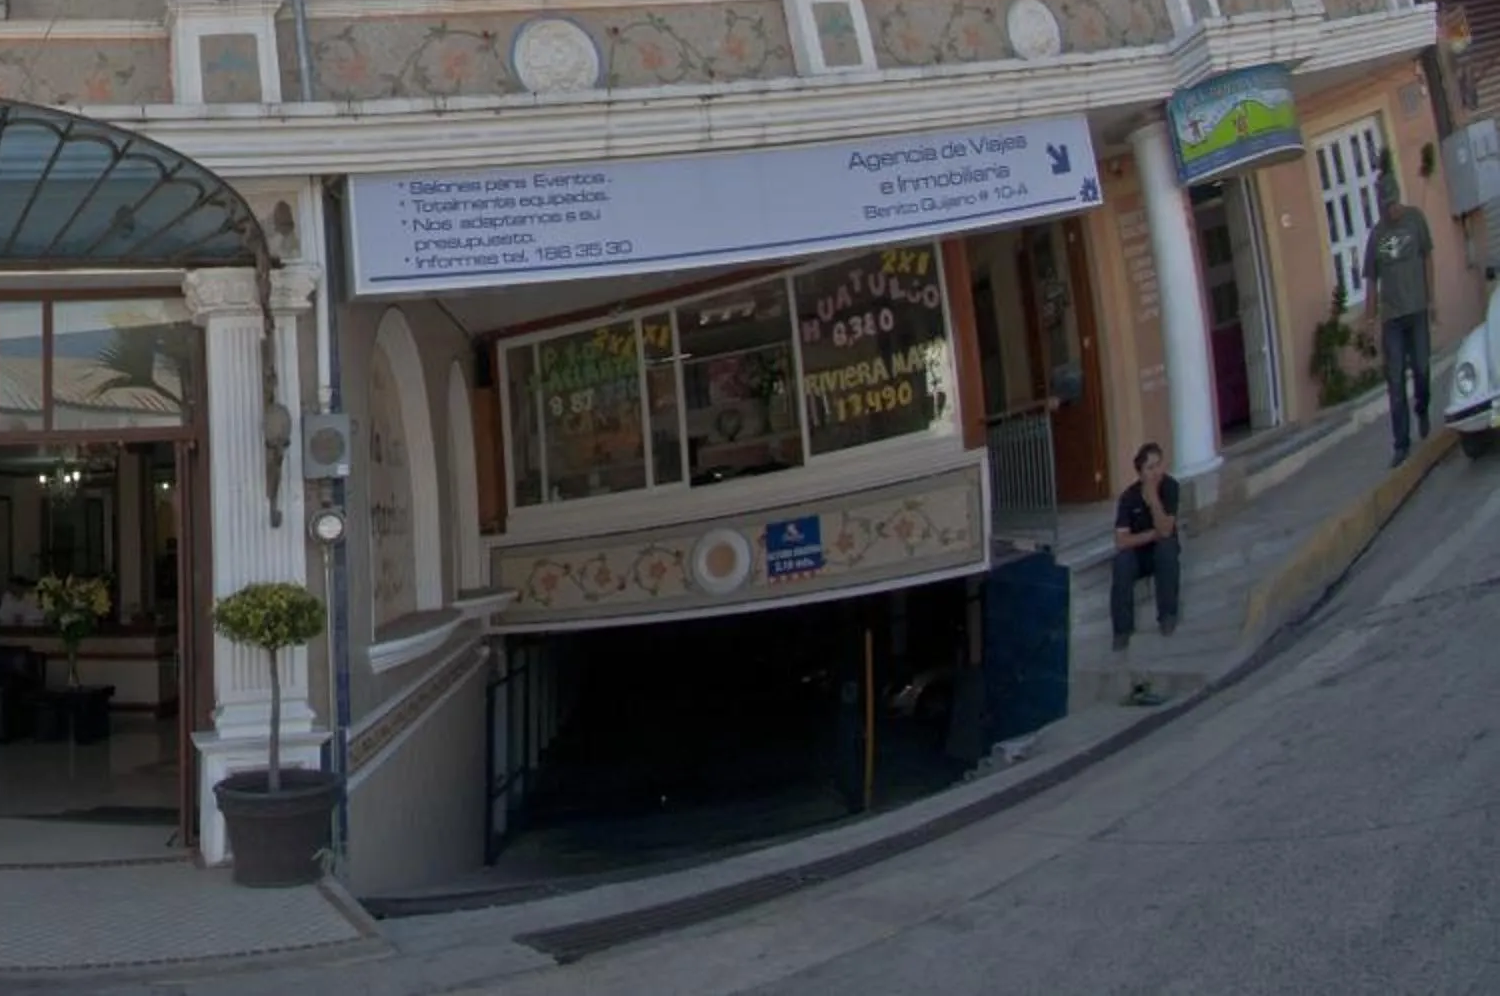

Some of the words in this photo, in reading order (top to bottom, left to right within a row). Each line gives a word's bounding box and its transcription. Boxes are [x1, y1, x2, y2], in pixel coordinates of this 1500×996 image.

[849, 147, 938, 171] Agencia
[941, 142, 966, 160] de
[969, 134, 1028, 156] Viajes
[880, 181, 894, 195] e
[897, 163, 1011, 193] Inmobiliaria
[413, 194, 516, 213] Totalmente
[413, 218, 452, 232] Nos
[459, 212, 563, 231] adaptamos
[415, 253, 499, 270] Informes
